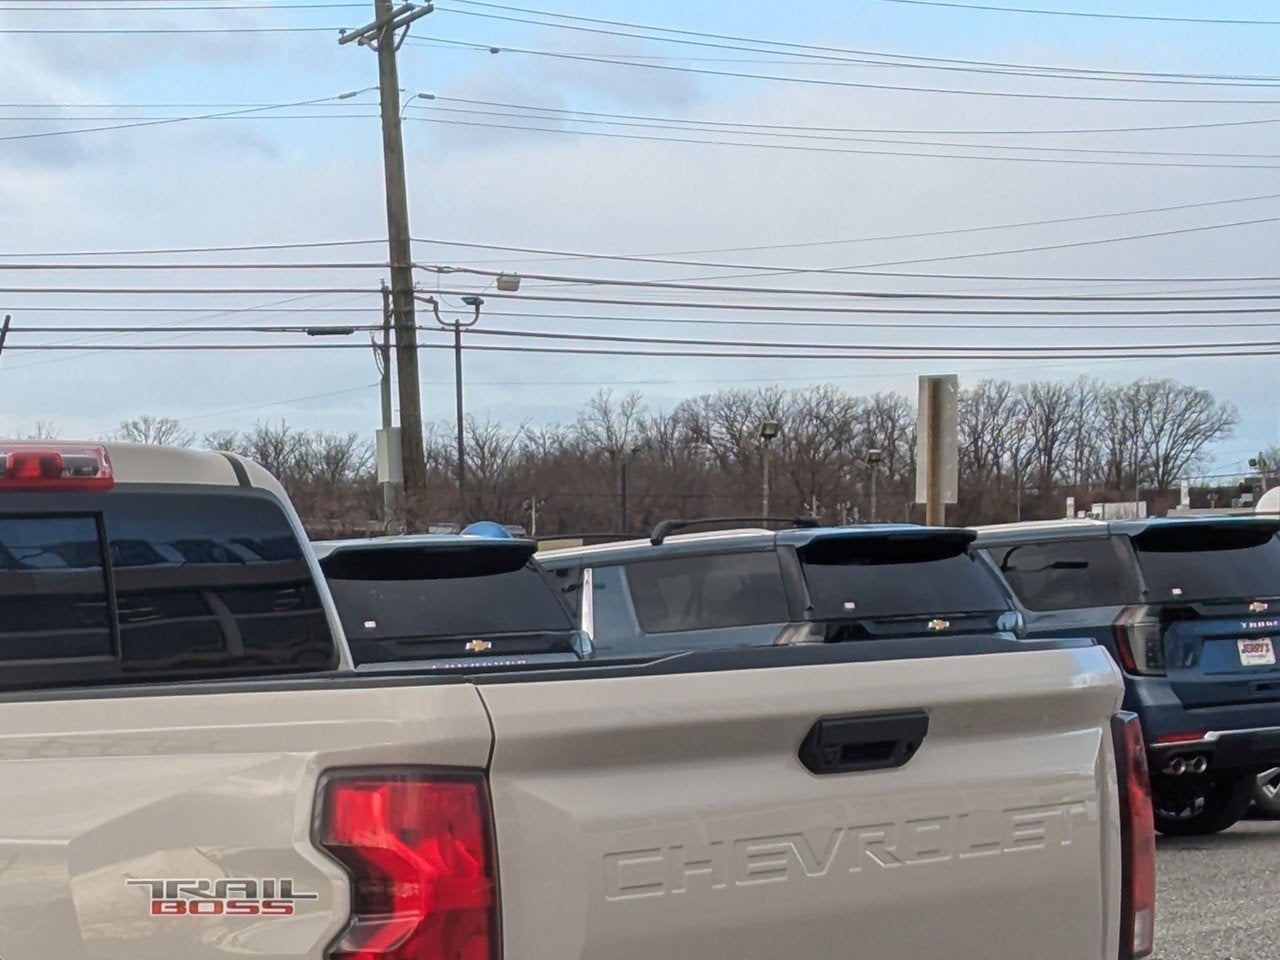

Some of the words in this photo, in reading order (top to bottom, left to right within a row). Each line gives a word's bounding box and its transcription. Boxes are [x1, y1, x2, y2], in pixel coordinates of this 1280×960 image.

[603, 799, 1086, 901] CHEVROLET
[126, 878, 318, 900] TRAIL
[150, 899, 294, 916] BOSS
